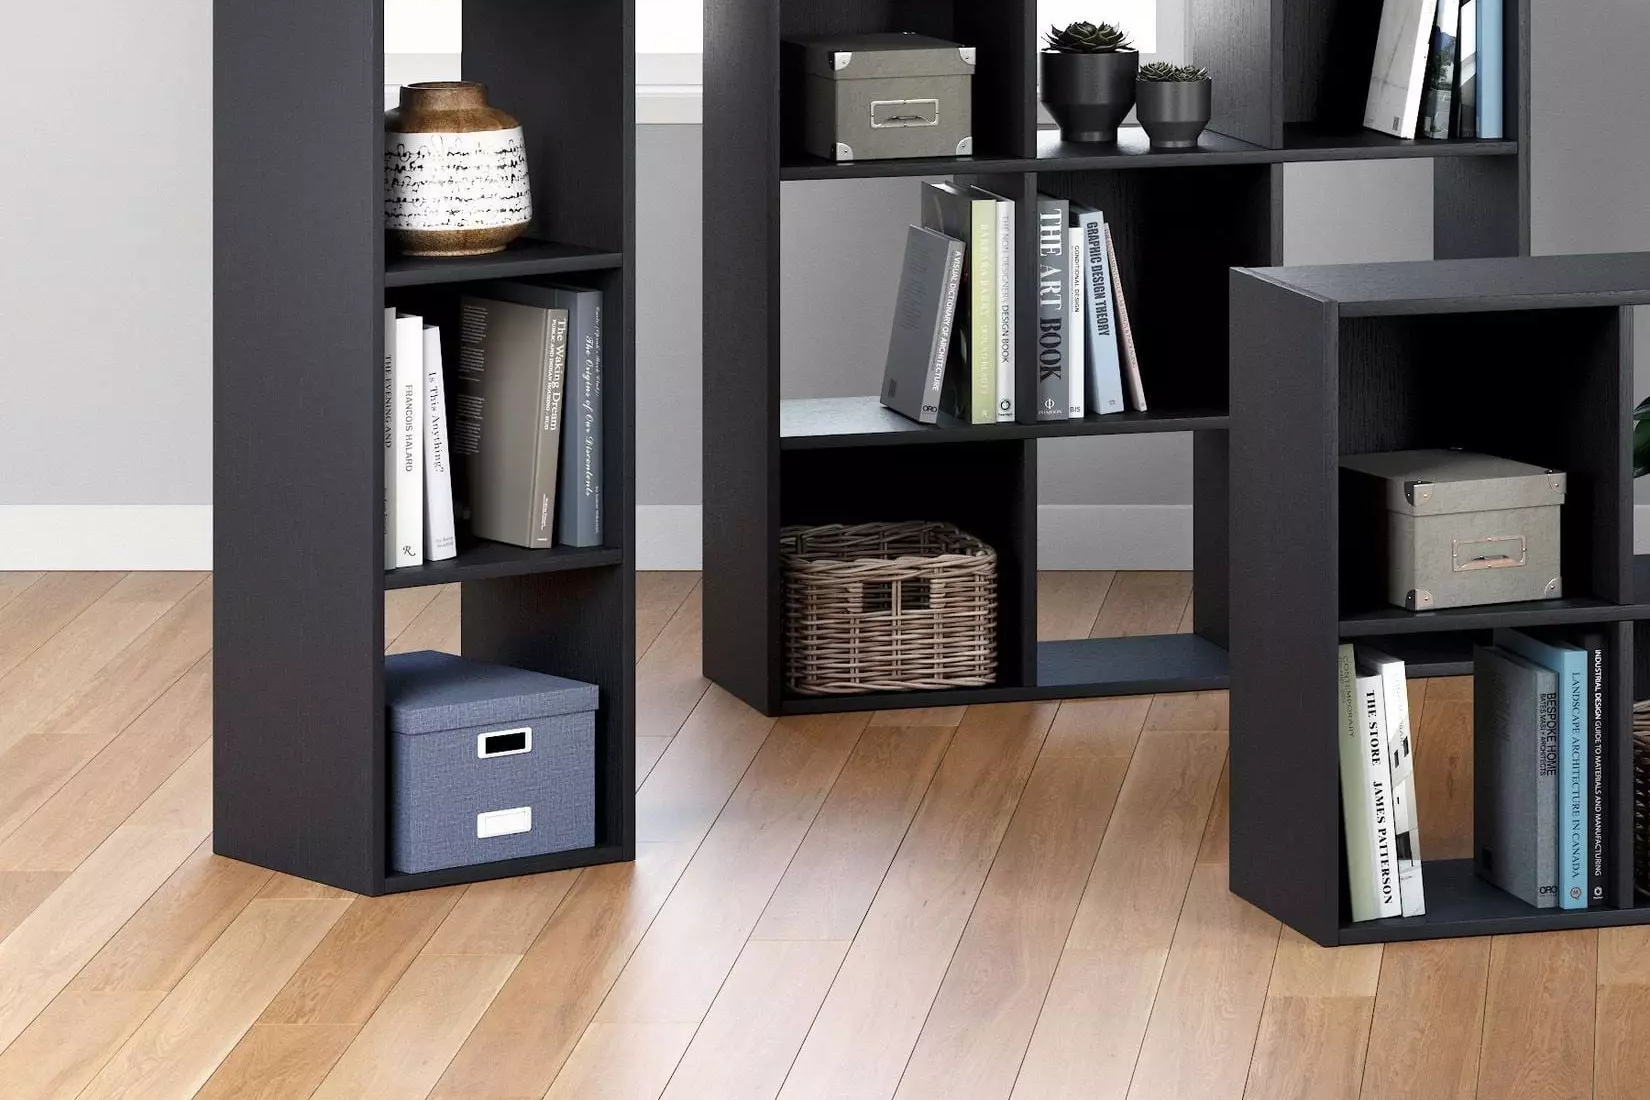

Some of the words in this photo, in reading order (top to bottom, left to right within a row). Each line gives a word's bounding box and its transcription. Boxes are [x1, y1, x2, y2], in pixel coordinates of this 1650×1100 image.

[1001, 215, 1009, 232] THE
[1040, 208, 1062, 257] THE
[1087, 221, 1102, 263] GRAPHIC
[950, 257, 960, 282] VISUAL
[1040, 264, 1062, 311] ART
[1091, 264, 1105, 299] DESIGN
[944, 283, 957, 326] DICTIONARY
[1001, 305, 1009, 337] DESIGN
[1095, 300, 1110, 336] THEORY
[555, 318, 567, 341] The
[584, 335, 594, 356] The
[942, 326, 949, 337] OF
[384, 354, 392, 375] THE
[551, 343, 565, 388] Waking
[932, 337, 947, 392] ARCHITECTURE
[1001, 338, 1009, 363] BOOK
[1039, 317, 1062, 382] BOOK
[583, 360, 594, 397] Origins
[384, 379, 392, 422] EVENING
[404, 385, 413, 432] FRANCOIS
[430, 386, 439, 411] This
[550, 392, 562, 431] Dream
[583, 399, 594, 411] of
[384, 426, 392, 448] AND
[404, 434, 413, 472] HALARD
[431, 416, 444, 473] Anything?
[583, 436, 594, 497] Discontents
[1594, 649, 1602, 691] INDUSTRIAL
[1343, 655, 1355, 740] CONTEMPORARY
[1366, 690, 1375, 716] THE
[1547, 692, 1557, 742] BESPOKE
[1572, 672, 1580, 734] LANDSCAPE
[1594, 692, 1602, 720] DESIGN
[1367, 720, 1381, 765] STORE
[1594, 720, 1602, 743] GUIDE
[1594, 744, 1602, 755] TO
[1547, 744, 1557, 776] HOME
[1572, 737, 1580, 817] ARCHITECTURE
[1594, 755, 1602, 795] MATERIALS
[1373, 781, 1386, 824] JAMES
[1594, 796, 1602, 812] AND
[1572, 819, 1580, 831] IN
[1572, 832, 1580, 879] CANADA
[1594, 813, 1602, 877] MANUFACTURING
[1377, 828, 1393, 905] PATTERSON
